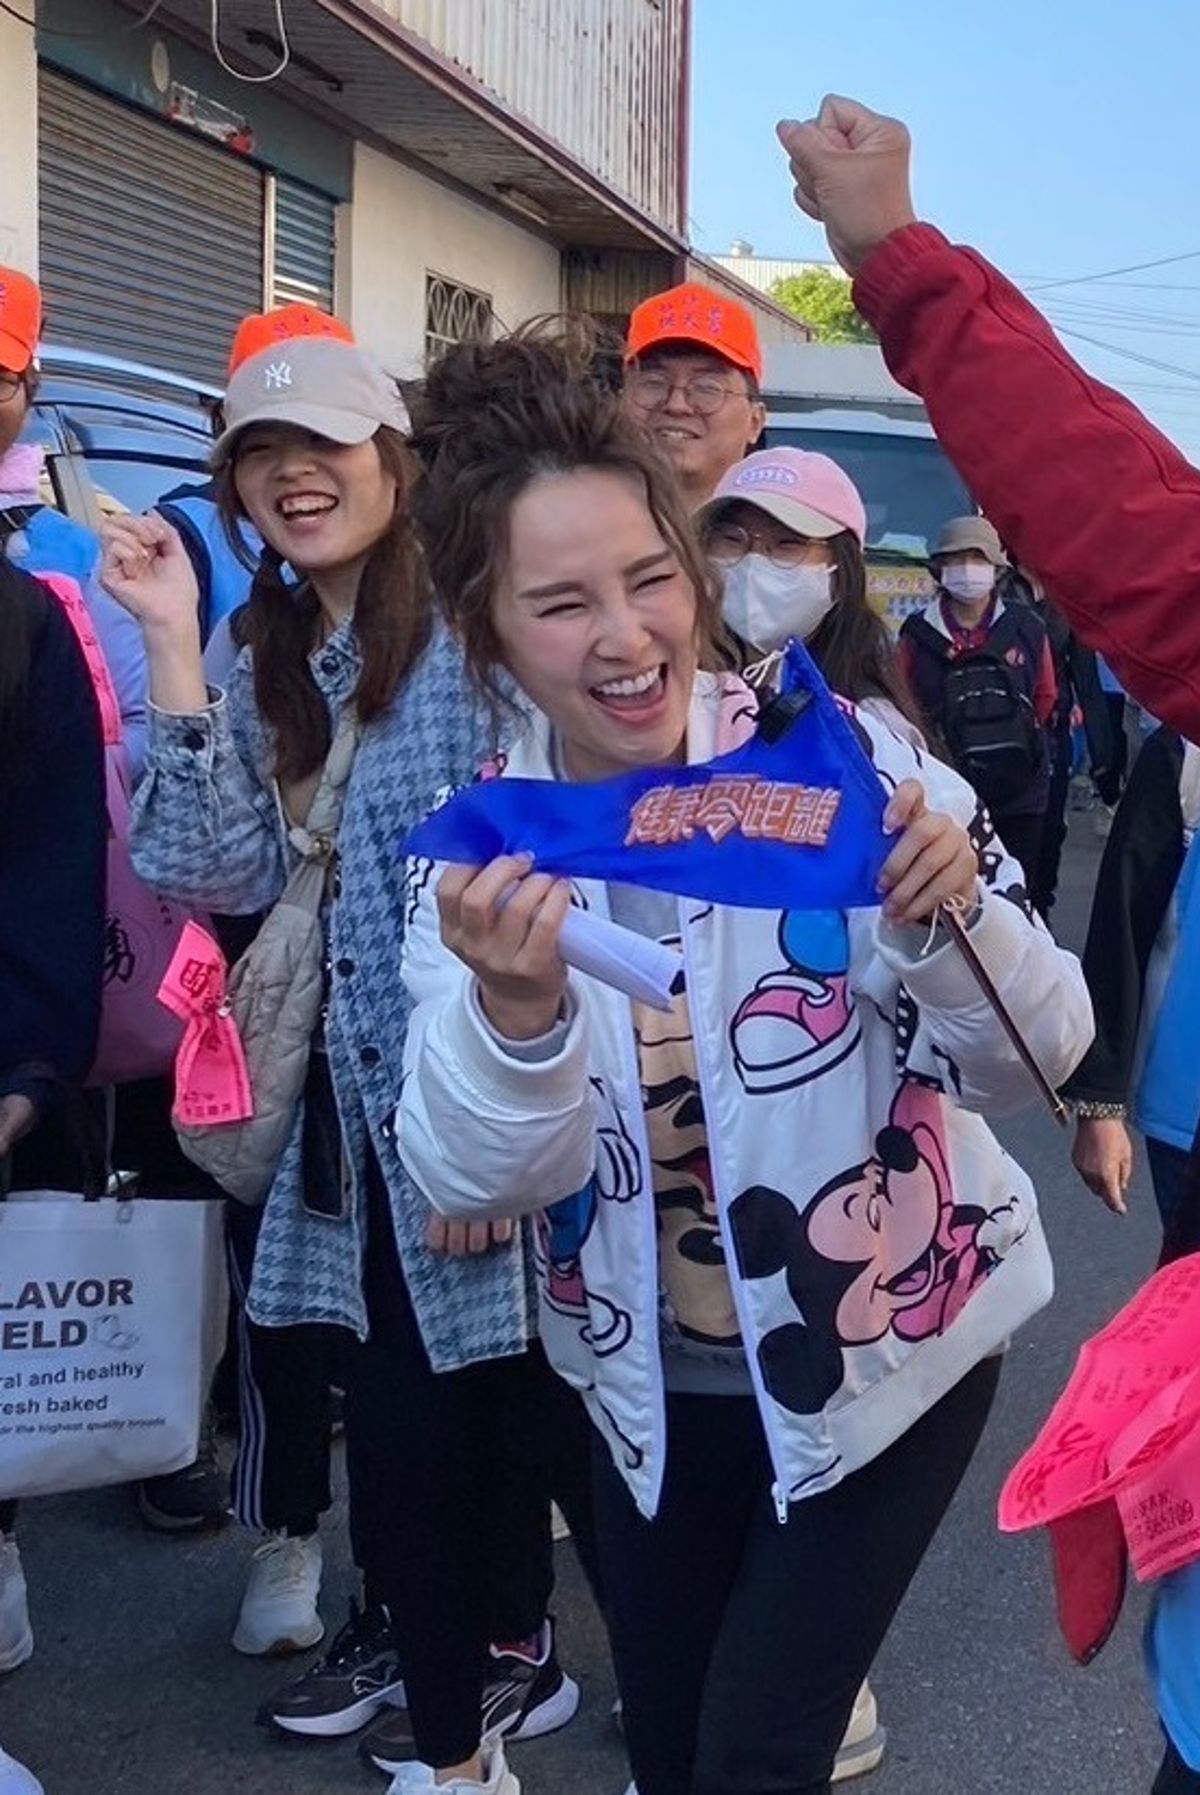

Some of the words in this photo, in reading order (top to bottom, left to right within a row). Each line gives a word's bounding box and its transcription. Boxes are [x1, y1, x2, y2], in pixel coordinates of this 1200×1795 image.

[264, 361, 292, 389] NY
[28, 1368, 66, 1387] and
[73, 1361, 145, 1383] healthy
[47, 1395, 108, 1413] baked
